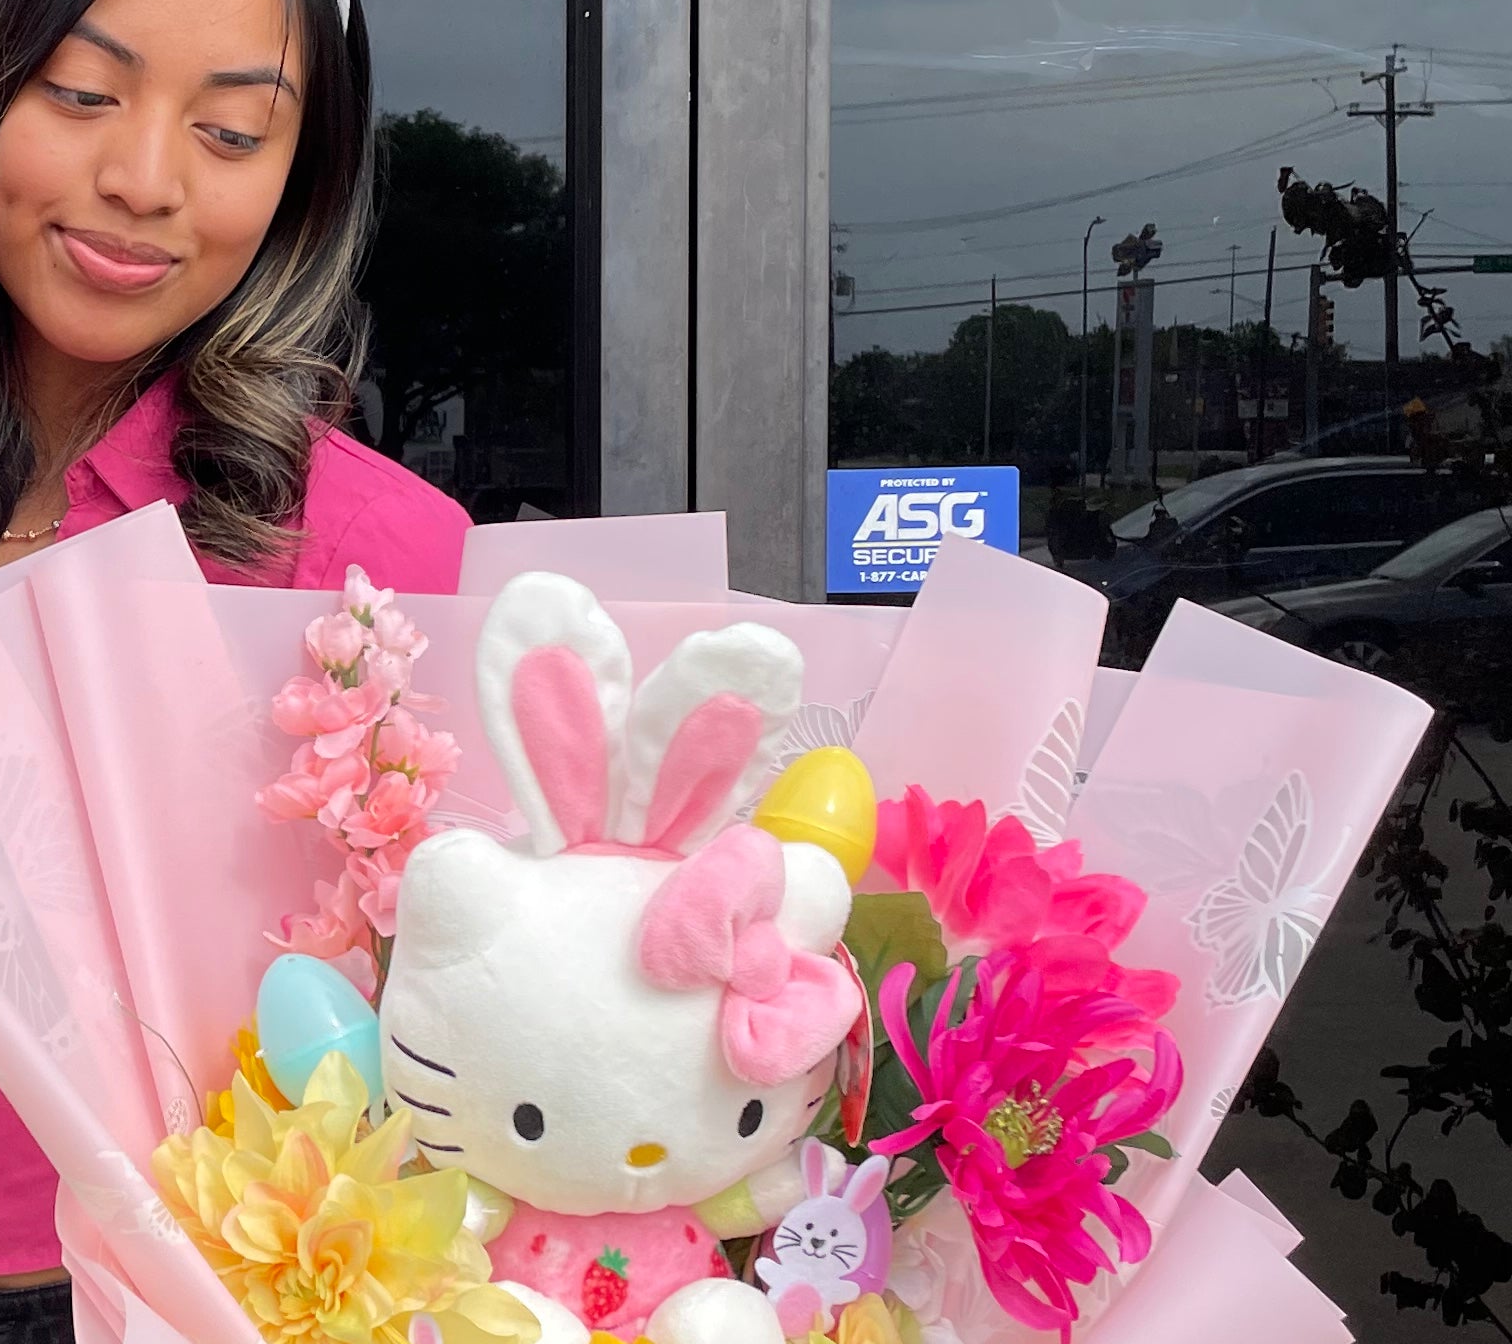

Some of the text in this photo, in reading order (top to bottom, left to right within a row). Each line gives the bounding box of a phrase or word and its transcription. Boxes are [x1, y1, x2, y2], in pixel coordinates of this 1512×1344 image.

[880, 477, 956, 488] PROTECTED BY
[853, 492, 985, 541] ASG
